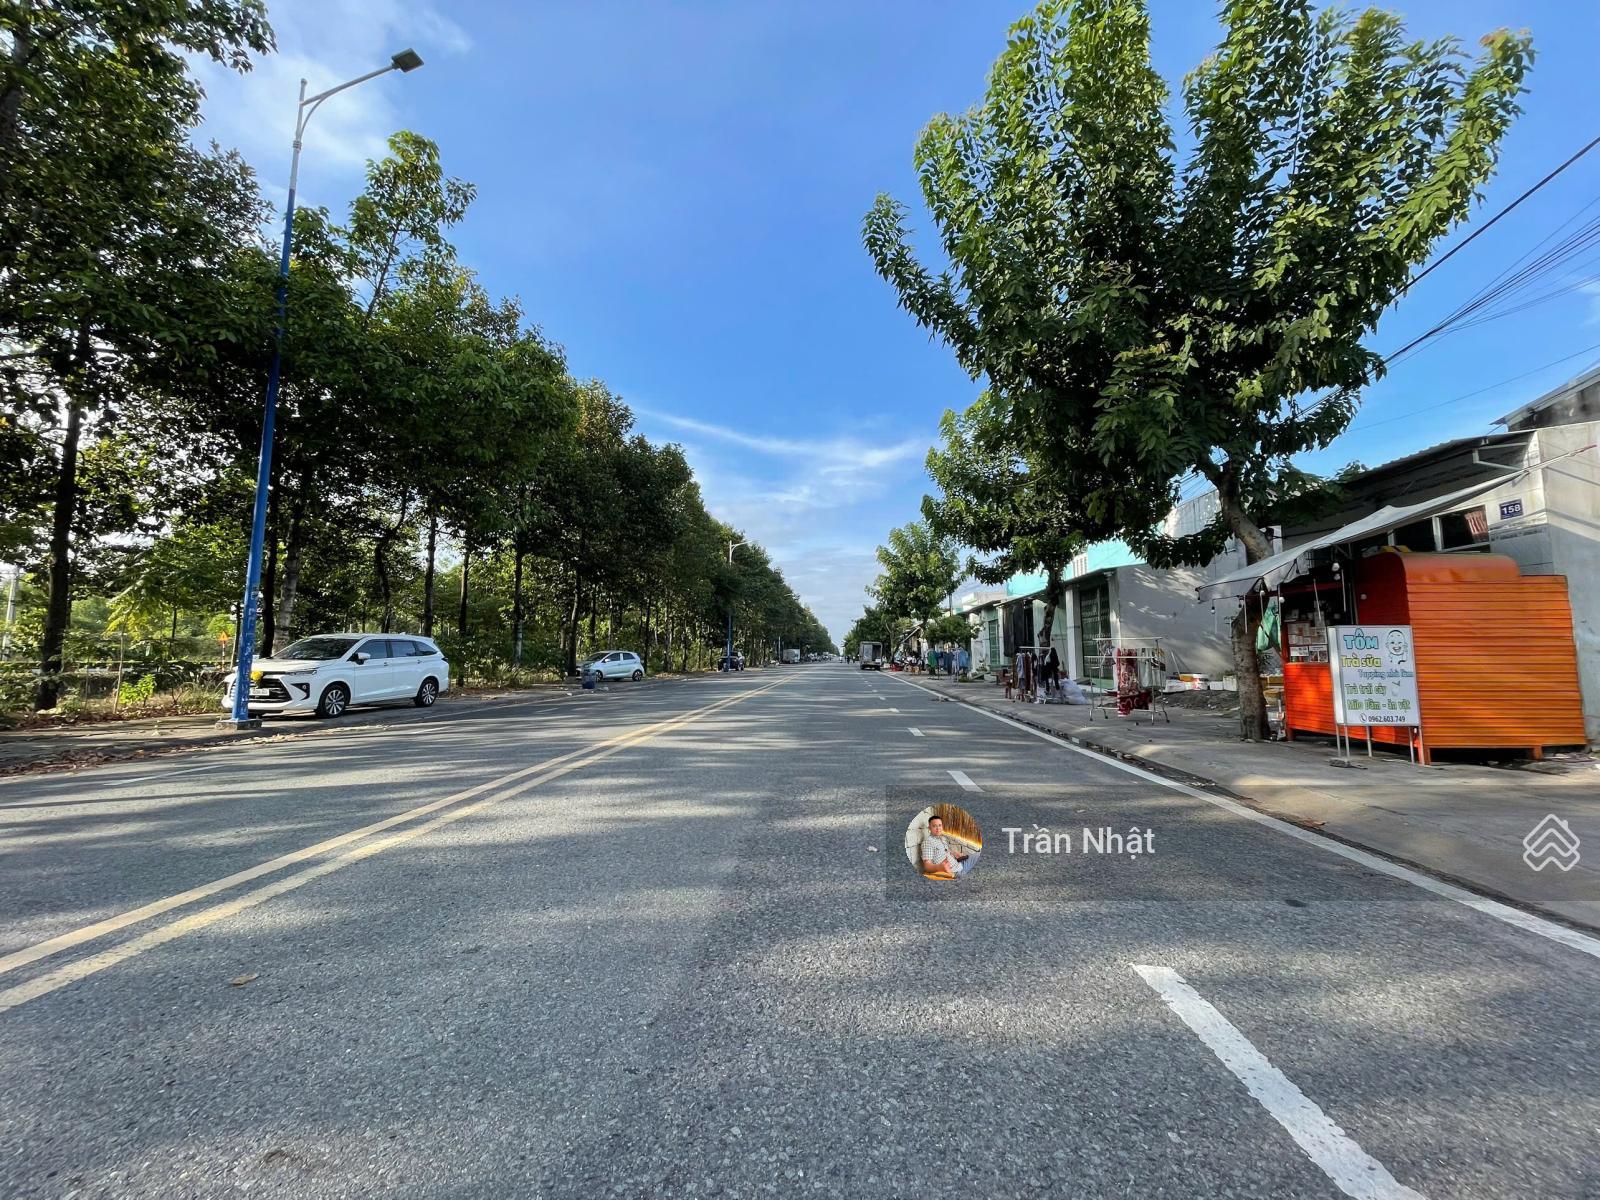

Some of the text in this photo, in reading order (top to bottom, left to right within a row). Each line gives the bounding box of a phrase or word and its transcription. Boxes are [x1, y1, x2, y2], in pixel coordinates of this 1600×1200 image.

[1501, 504, 1521, 515] 158
[1343, 628, 1379, 650] TÔM
[1341, 653, 1382, 667] Trà sữa
[1368, 715, 1406, 723] 0962.603.749
